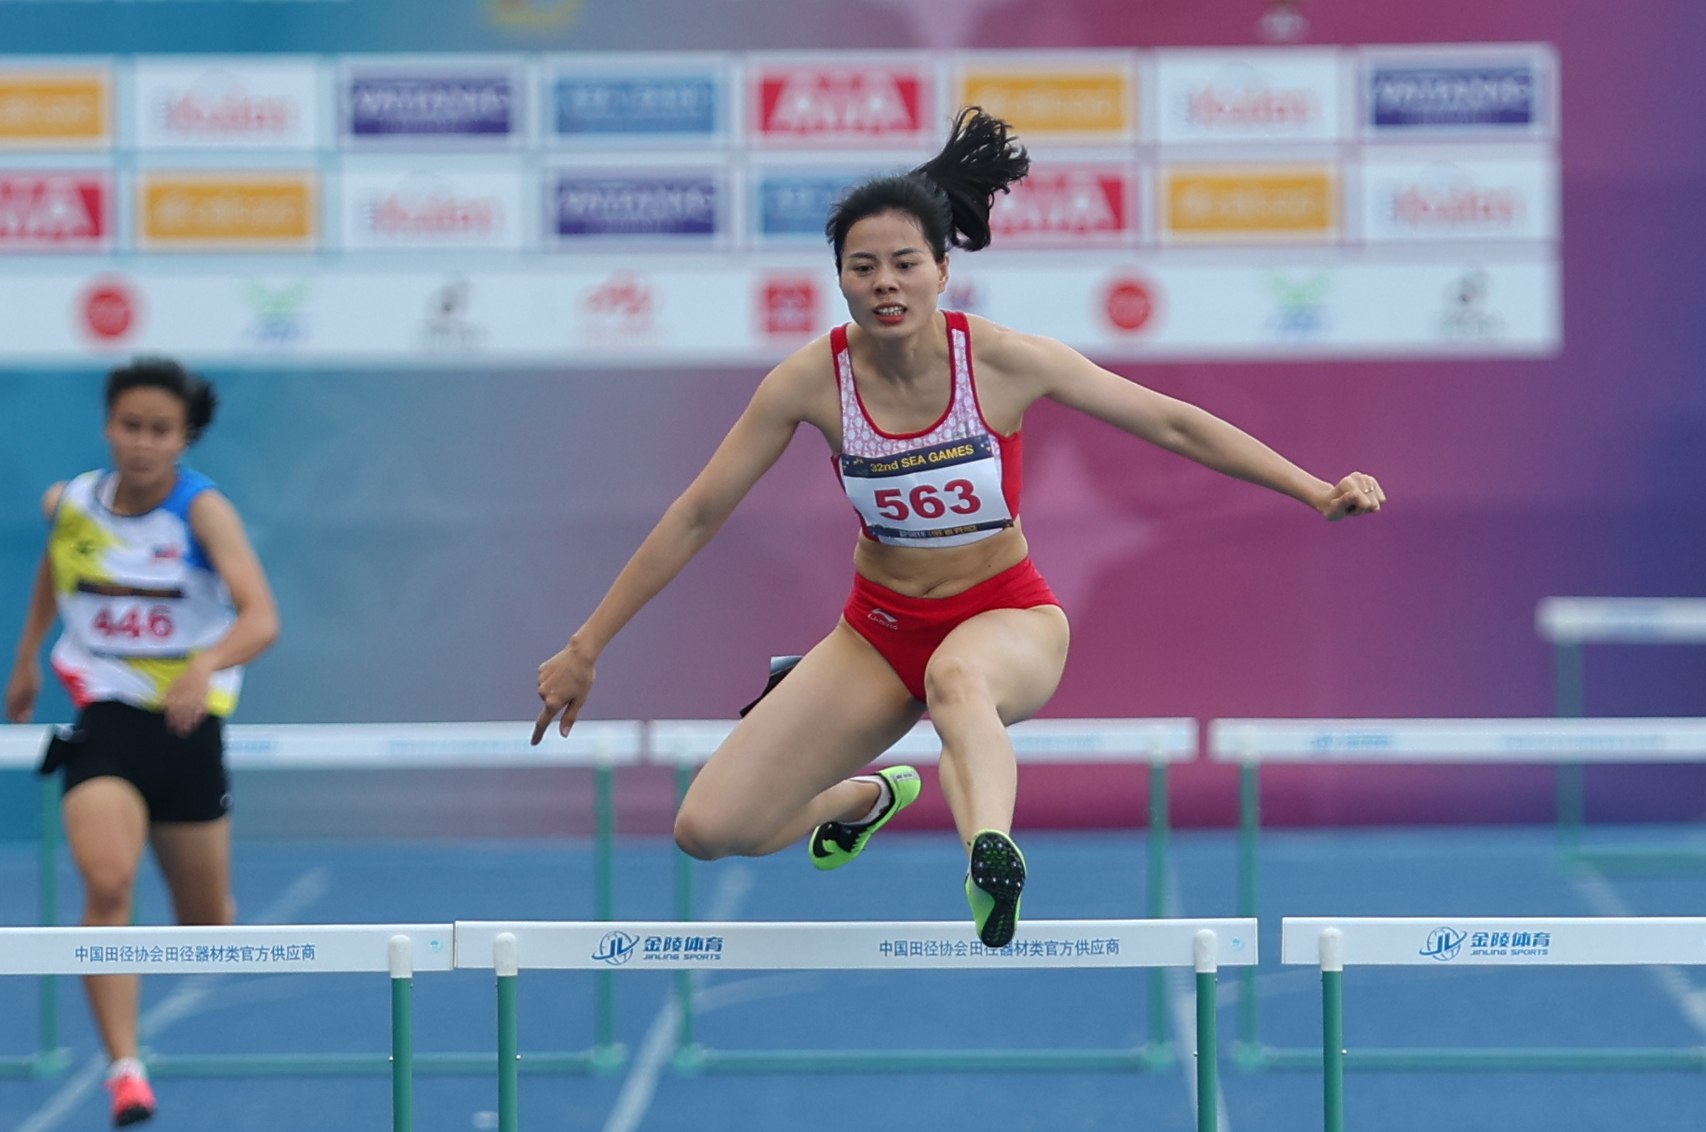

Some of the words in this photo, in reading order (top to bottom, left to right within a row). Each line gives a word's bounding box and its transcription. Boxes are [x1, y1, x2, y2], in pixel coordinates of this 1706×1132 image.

[870, 460, 899, 472] 32nd
[901, 455, 926, 468] SEA
[928, 444, 974, 462] GAMES
[874, 478, 981, 521] 563
[93, 605, 175, 639] 446
[643, 936, 723, 952] 金陵体育
[1470, 932, 1551, 947] 金陵体育
[75, 943, 316, 962] 中国田径协会田径器材类官方供应商
